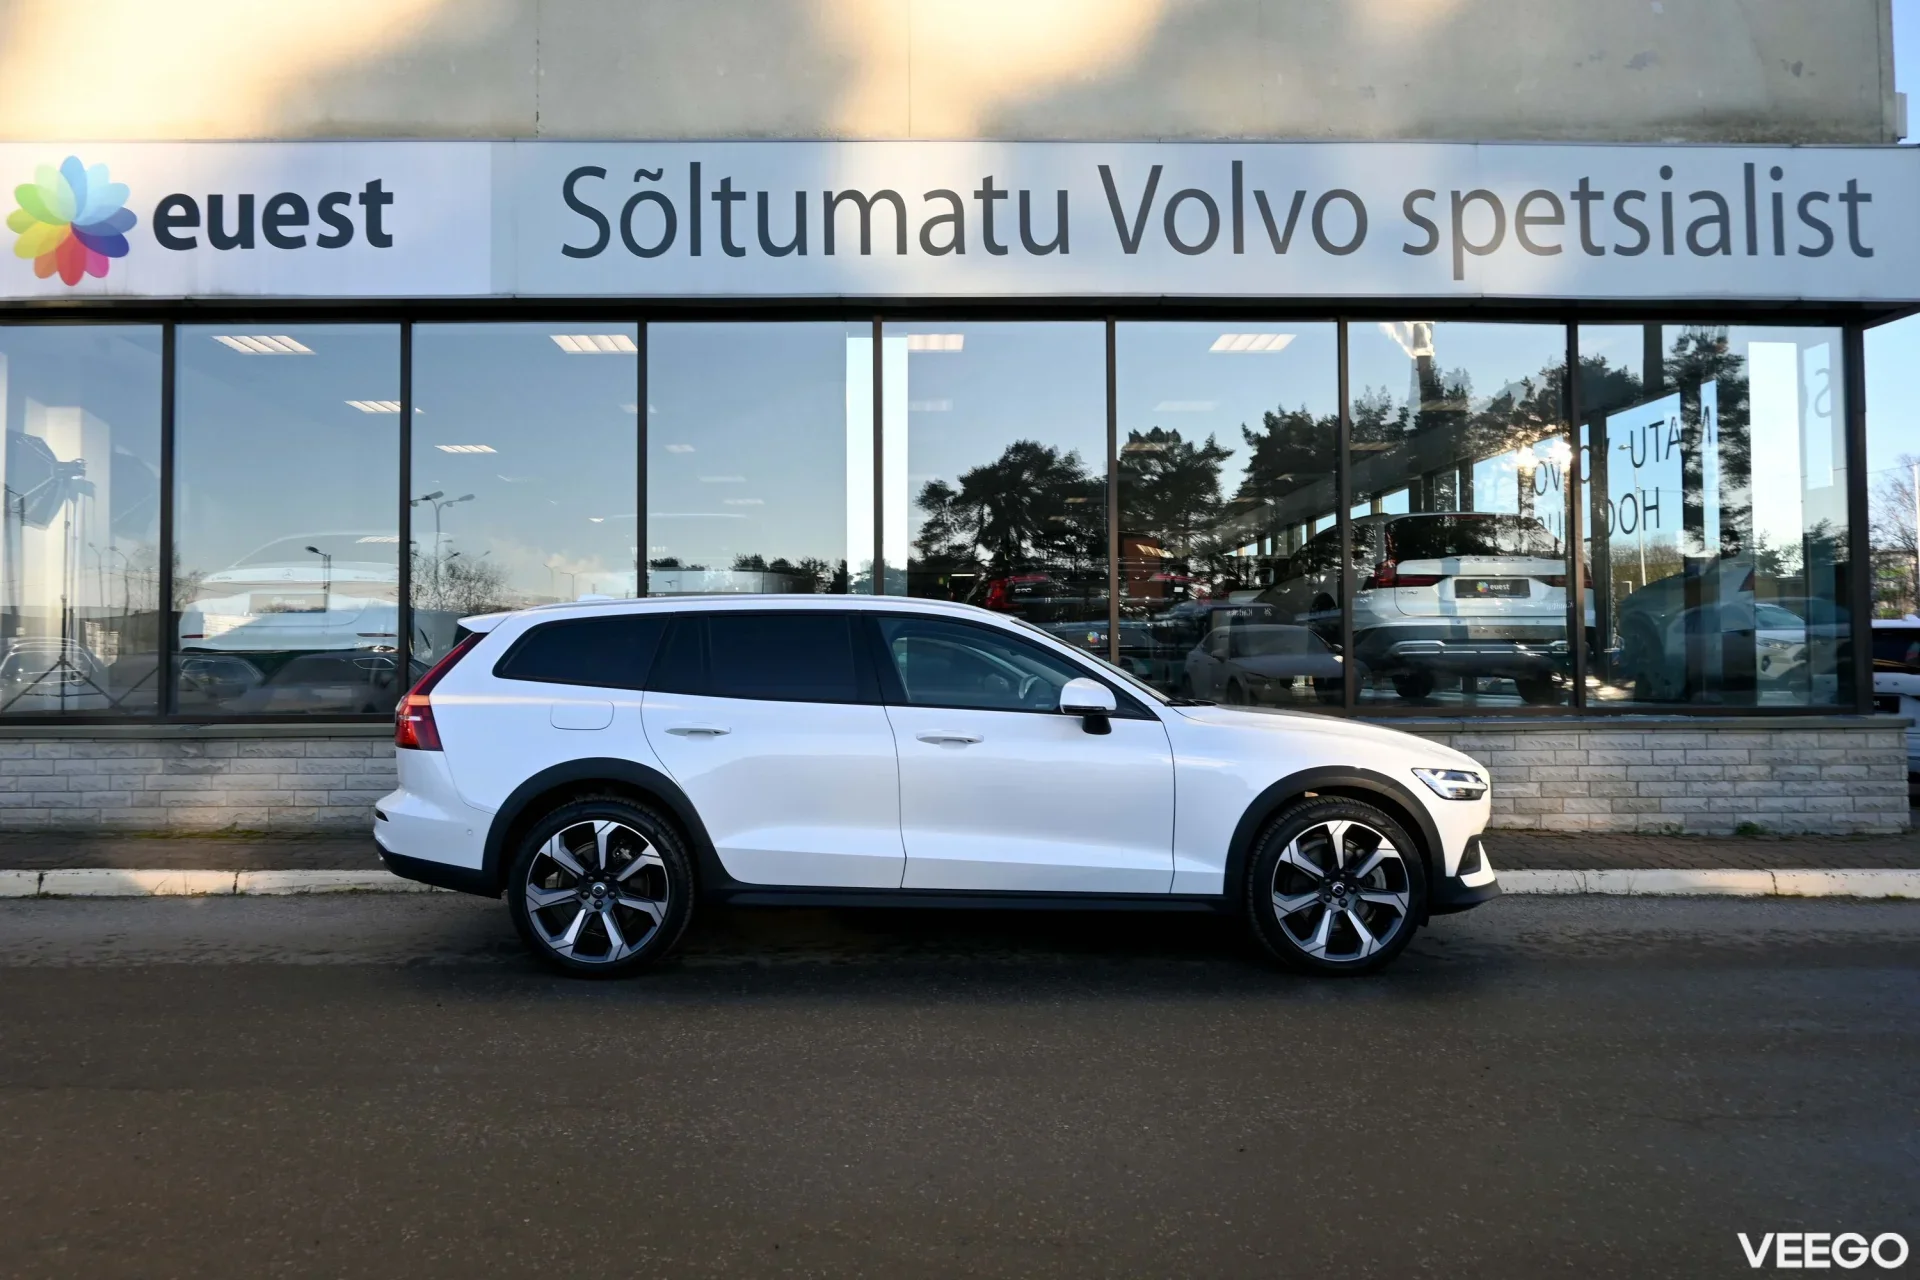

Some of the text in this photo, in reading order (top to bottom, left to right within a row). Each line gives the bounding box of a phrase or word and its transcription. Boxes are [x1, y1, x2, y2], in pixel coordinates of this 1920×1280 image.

[152, 178, 394, 251] euest
[561, 160, 1874, 281] Sõltumatu Volvo spetsialist
[1489, 583, 1511, 592] euest
